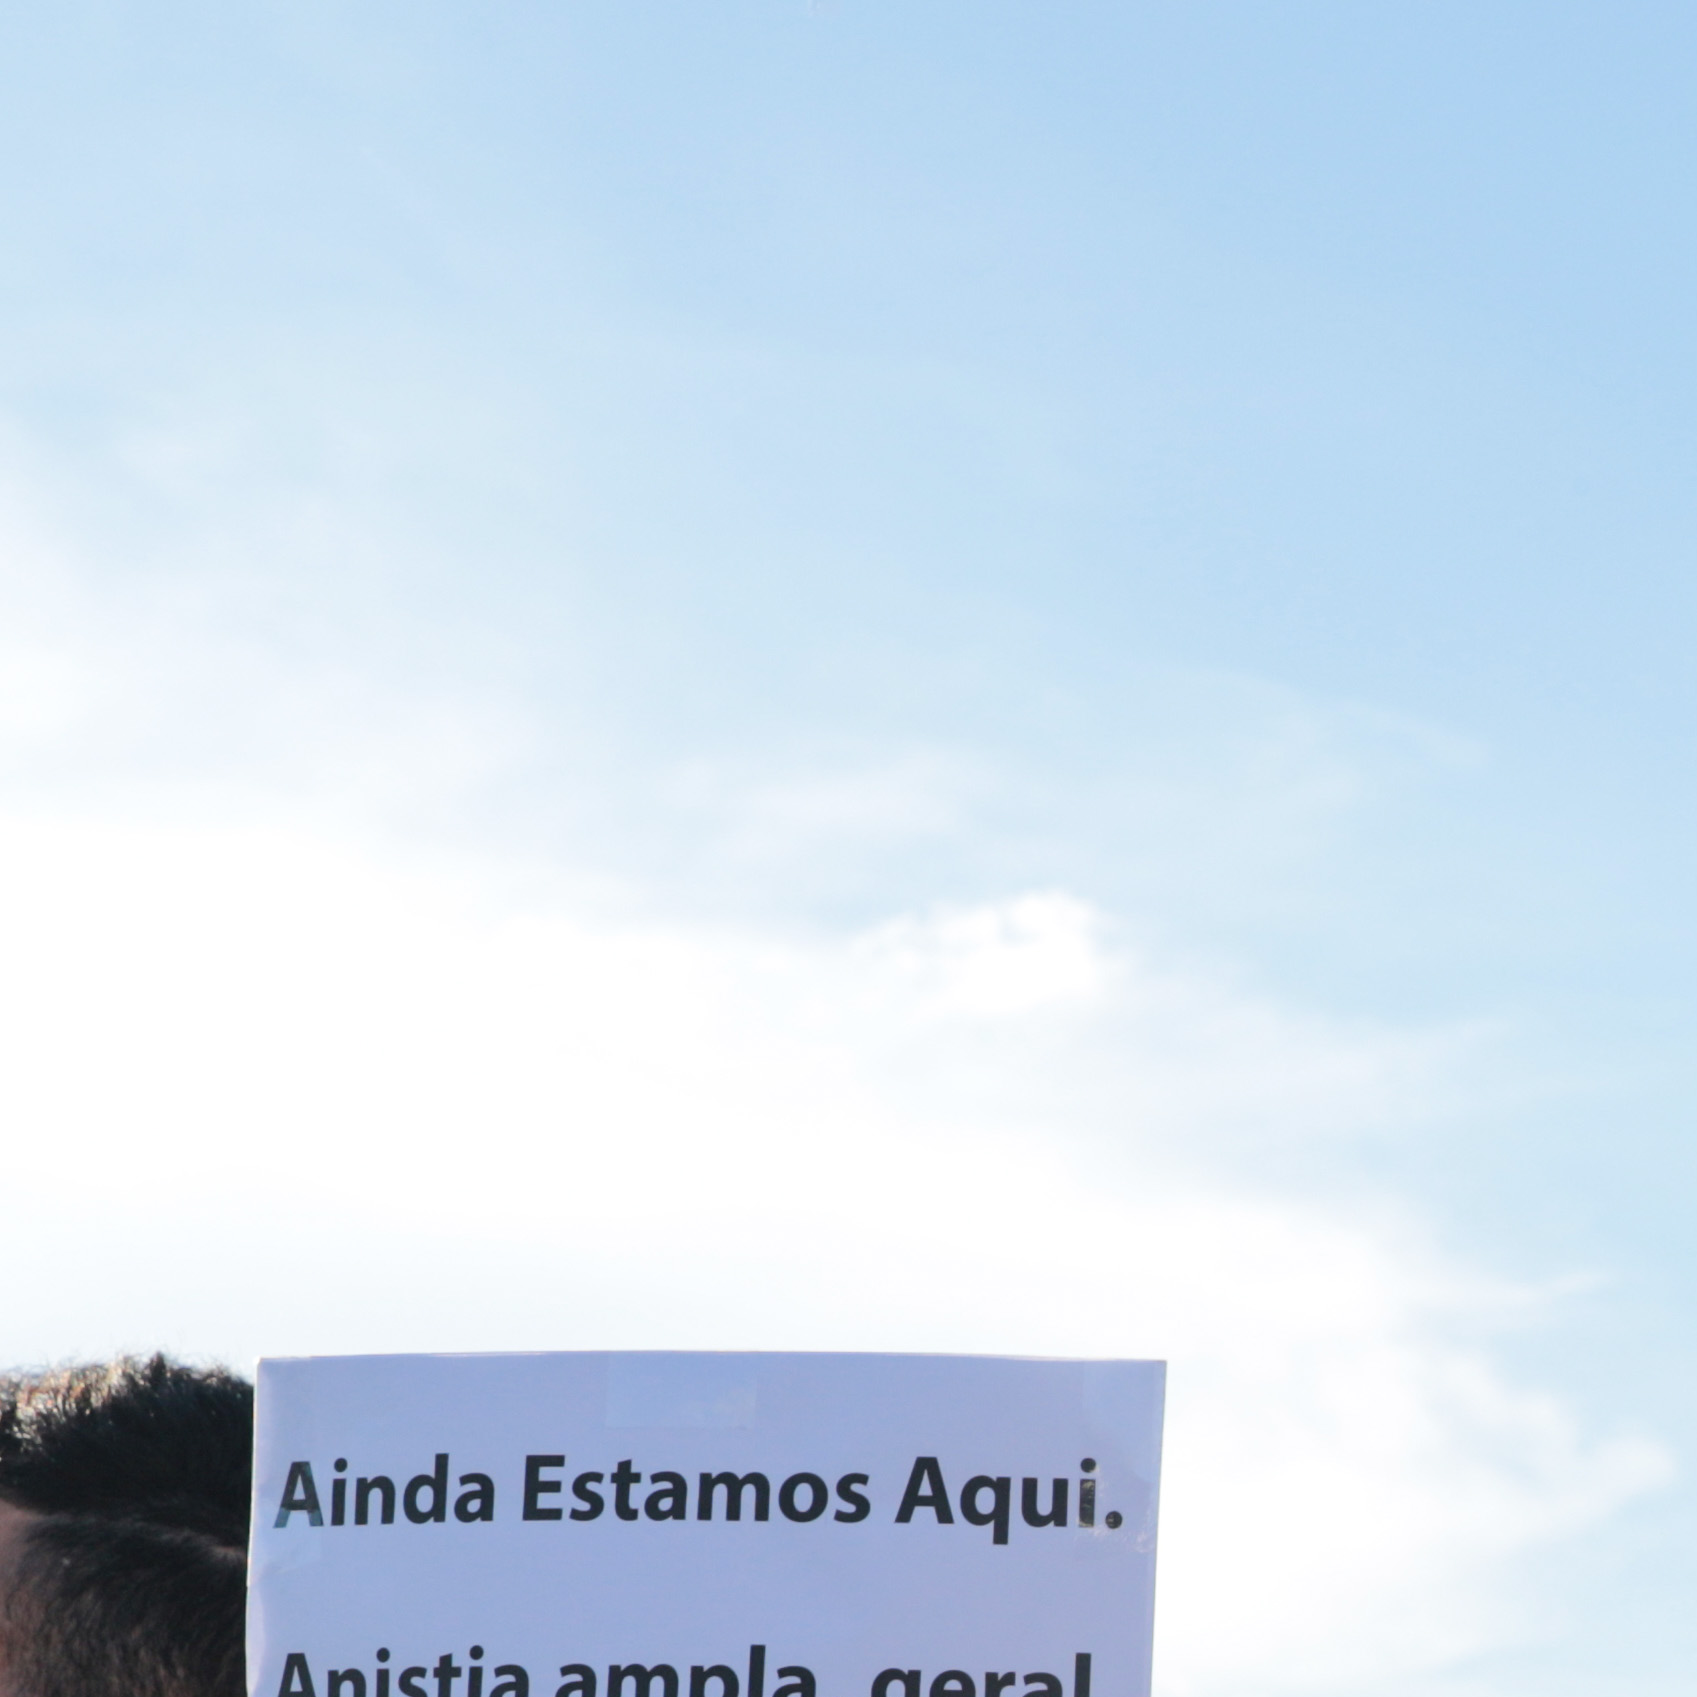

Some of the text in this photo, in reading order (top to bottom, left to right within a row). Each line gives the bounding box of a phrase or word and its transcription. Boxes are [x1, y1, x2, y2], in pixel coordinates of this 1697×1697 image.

[273, 1453, 1123, 1546] Ainda Estamos Aqui.
